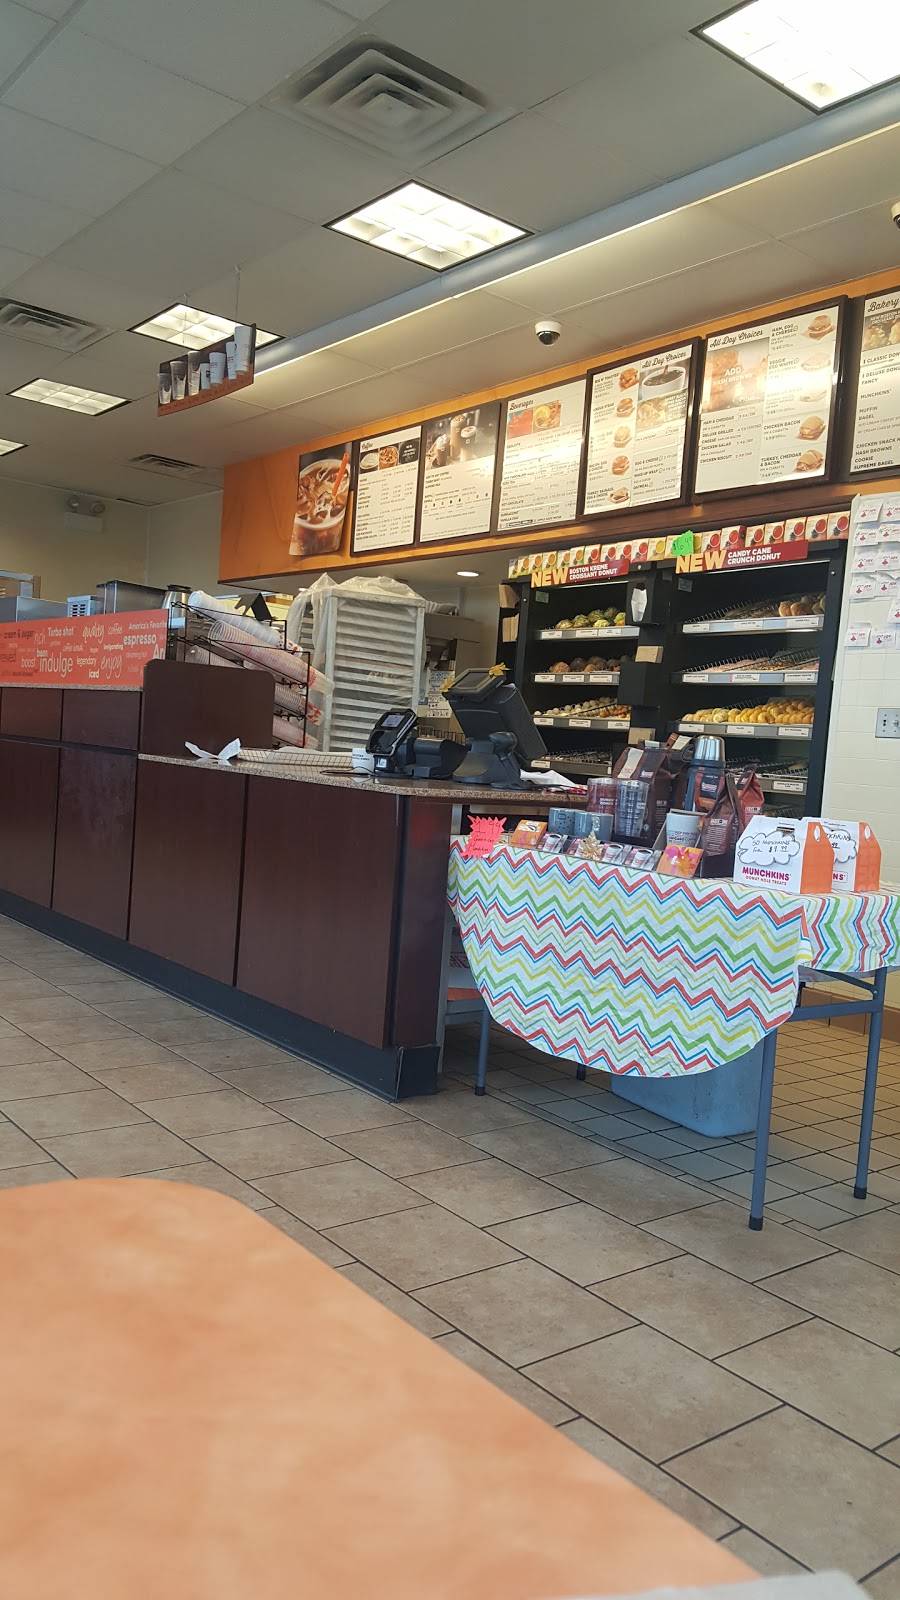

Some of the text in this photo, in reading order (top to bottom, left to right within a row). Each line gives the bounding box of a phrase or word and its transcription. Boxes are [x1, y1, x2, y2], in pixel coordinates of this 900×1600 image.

[868, 298, 900, 312] Bakery
[709, 339, 721, 348] All
[721, 334, 738, 345] Day
[738, 329, 763, 341] Choices
[642, 351, 688, 370] All Day Choices
[784, 419, 801, 427] BACON
[856, 441, 878, 449] CHICKEN
[856, 448, 869, 456] HASH
[853, 462, 877, 470] SUPREME
[728, 546, 772, 559] CANDY CANE
[728, 552, 781, 565] CRUNCH DONUT
[569, 563, 609, 575] BOSTON KREME
[675, 549, 727, 575] NEW
[531, 567, 569, 589] NEW
[569, 567, 618, 581] CROISSANT DONUT
[123, 634, 156, 648] espresso
[40, 650, 73, 678] indulge
[89, 668, 100, 679] iced
[742, 866, 789, 882] MUNCHKINS
